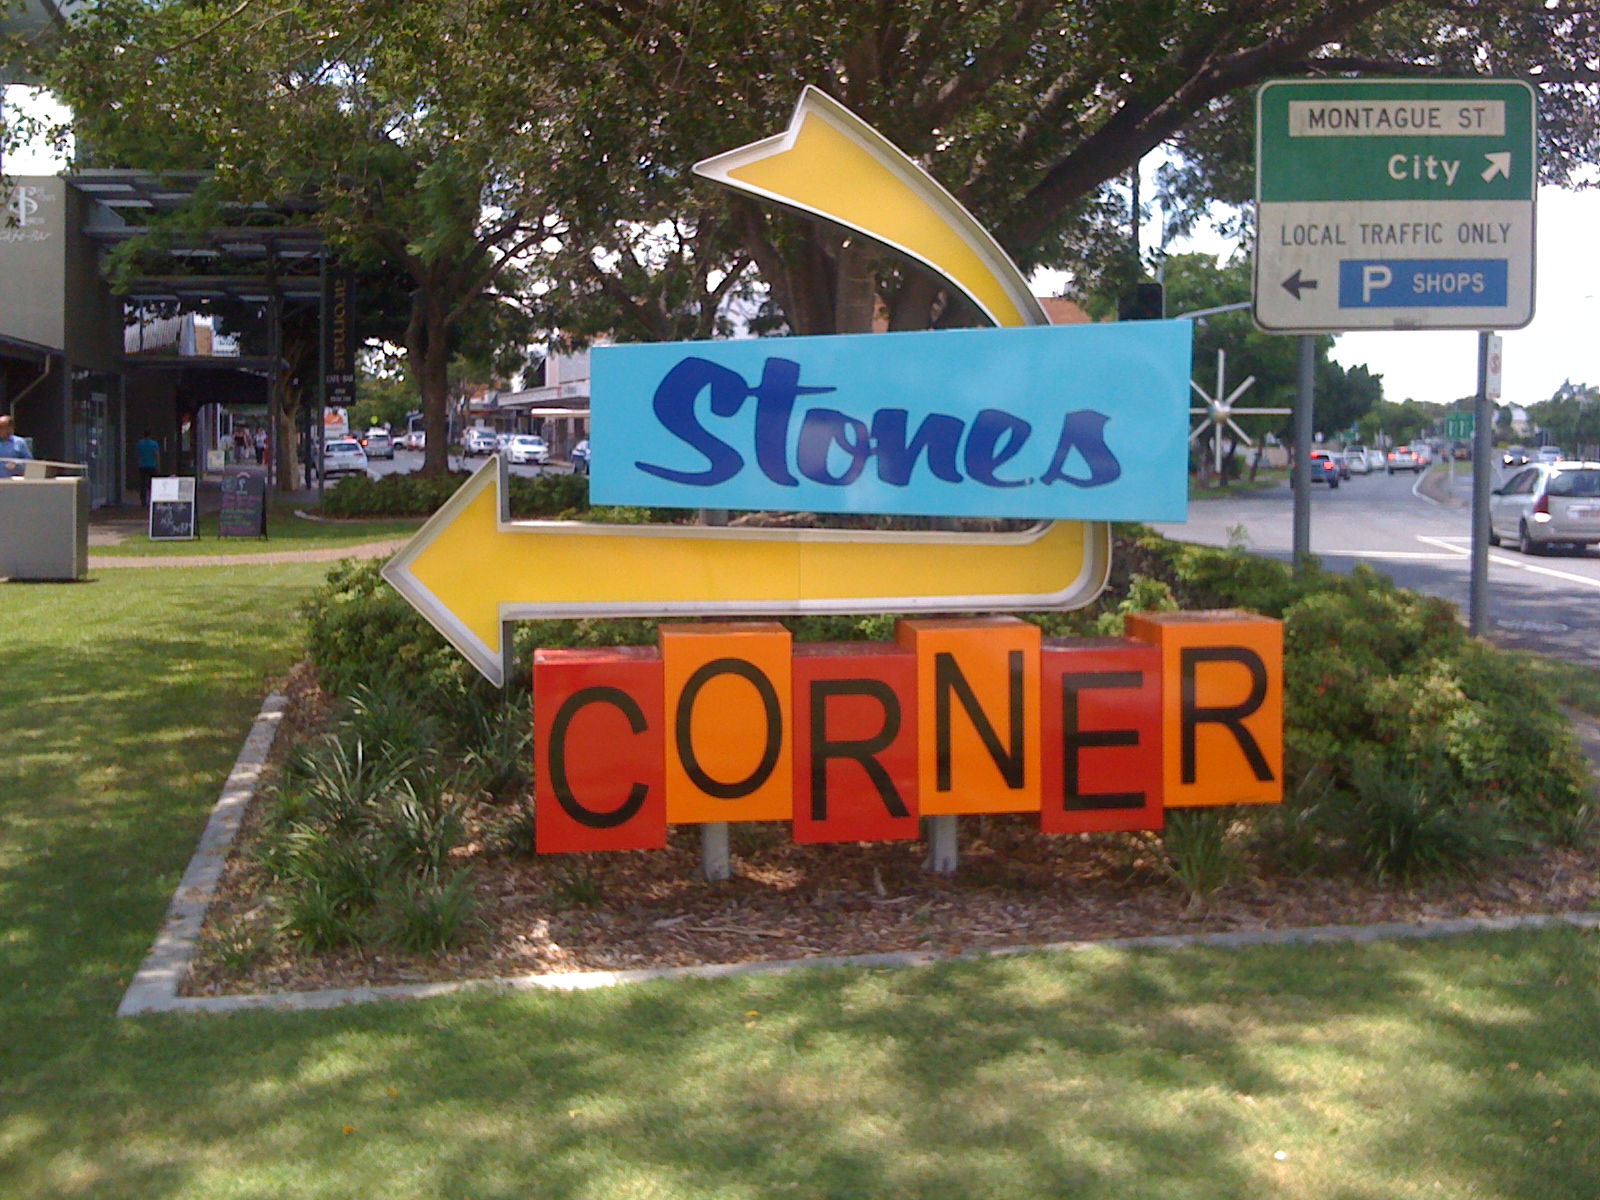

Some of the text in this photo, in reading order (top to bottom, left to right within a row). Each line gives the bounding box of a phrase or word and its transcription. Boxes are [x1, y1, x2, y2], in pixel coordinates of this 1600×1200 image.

[1308, 107, 1487, 130] MONTAGUE ST
[1388, 154, 1461, 186] City
[1281, 222, 1512, 247] LOCAL TRAFFIC ONLY
[1362, 265, 1485, 304] P SHOPS
[634, 357, 1122, 488] Stones
[547, 645, 1276, 829] CORNER
